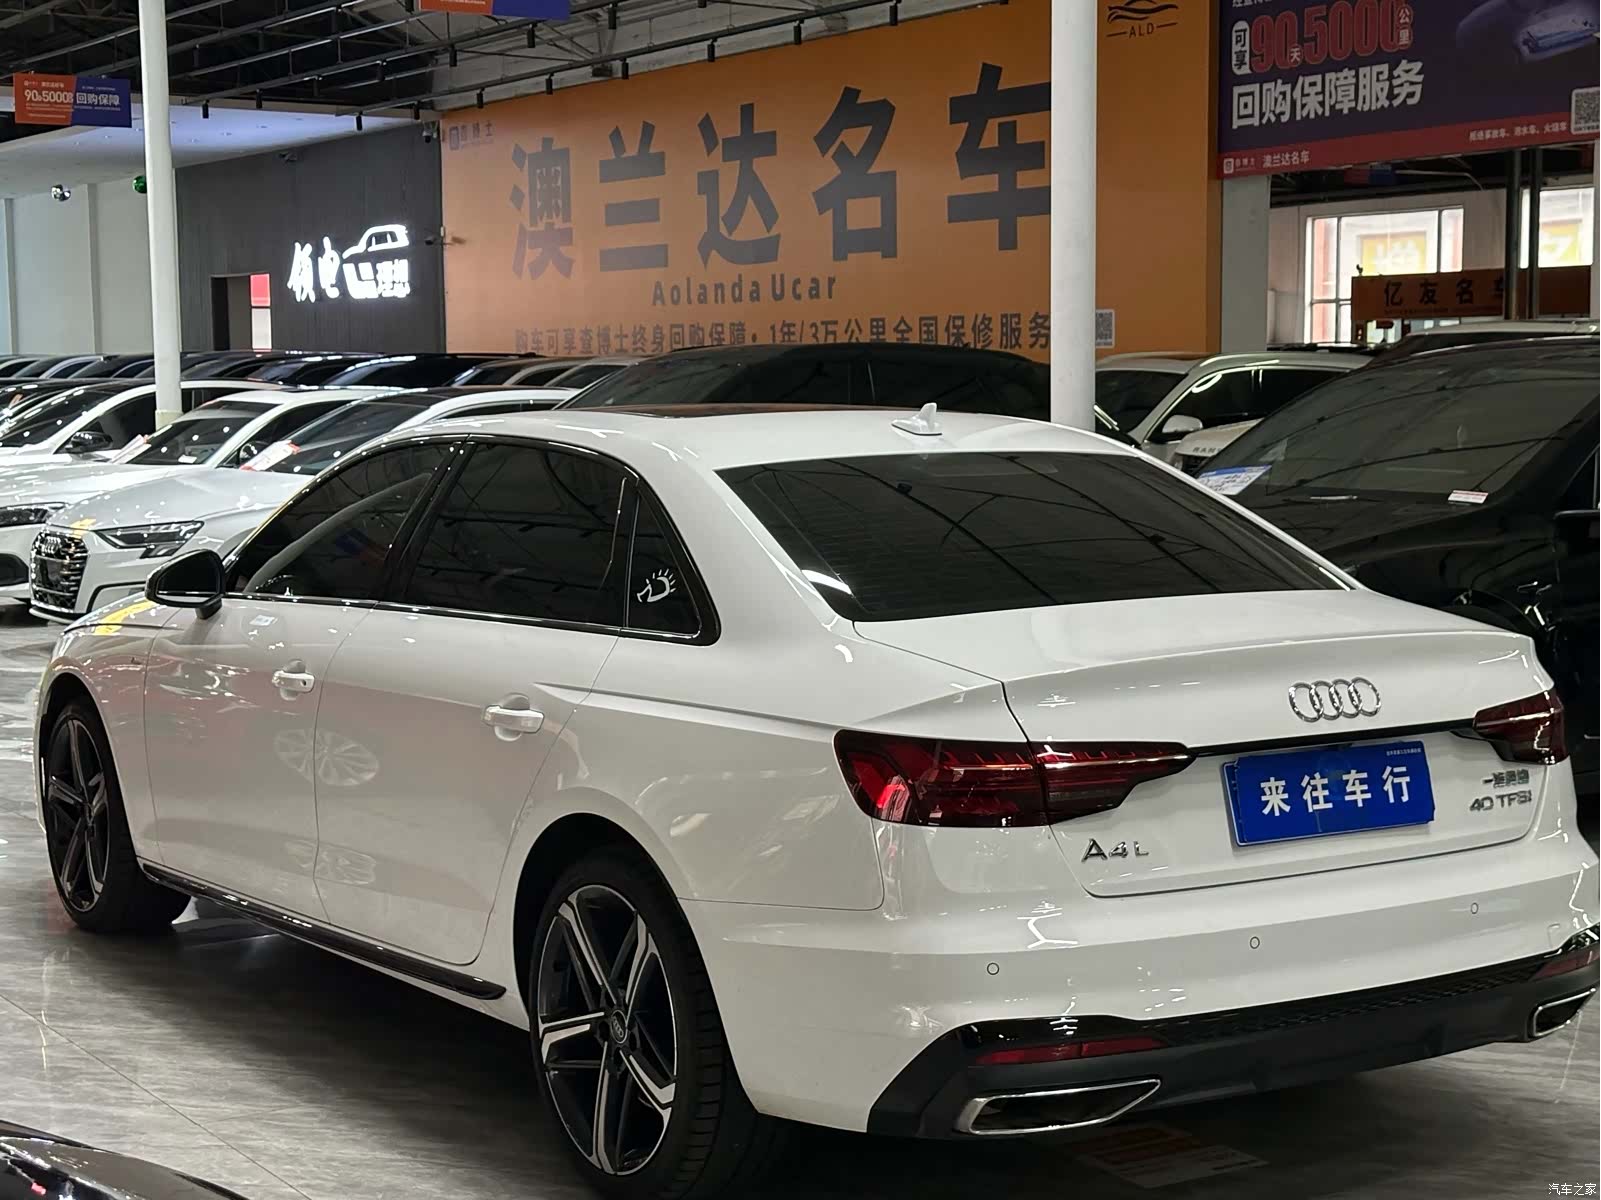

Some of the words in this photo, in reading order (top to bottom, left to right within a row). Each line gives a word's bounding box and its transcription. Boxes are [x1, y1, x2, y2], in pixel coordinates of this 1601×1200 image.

[1129, 22, 1155, 38] ALD
[1231, 59, 1425, 130] 回购保障服务
[509, 61, 1052, 281] 澳兰达名车
[652, 273, 761, 306] Aolanda
[771, 272, 837, 301] Ucar
[1259, 765, 1411, 817] 来往车行
[1469, 796, 1495, 811] 40
[1081, 838, 1150, 863] A4L
